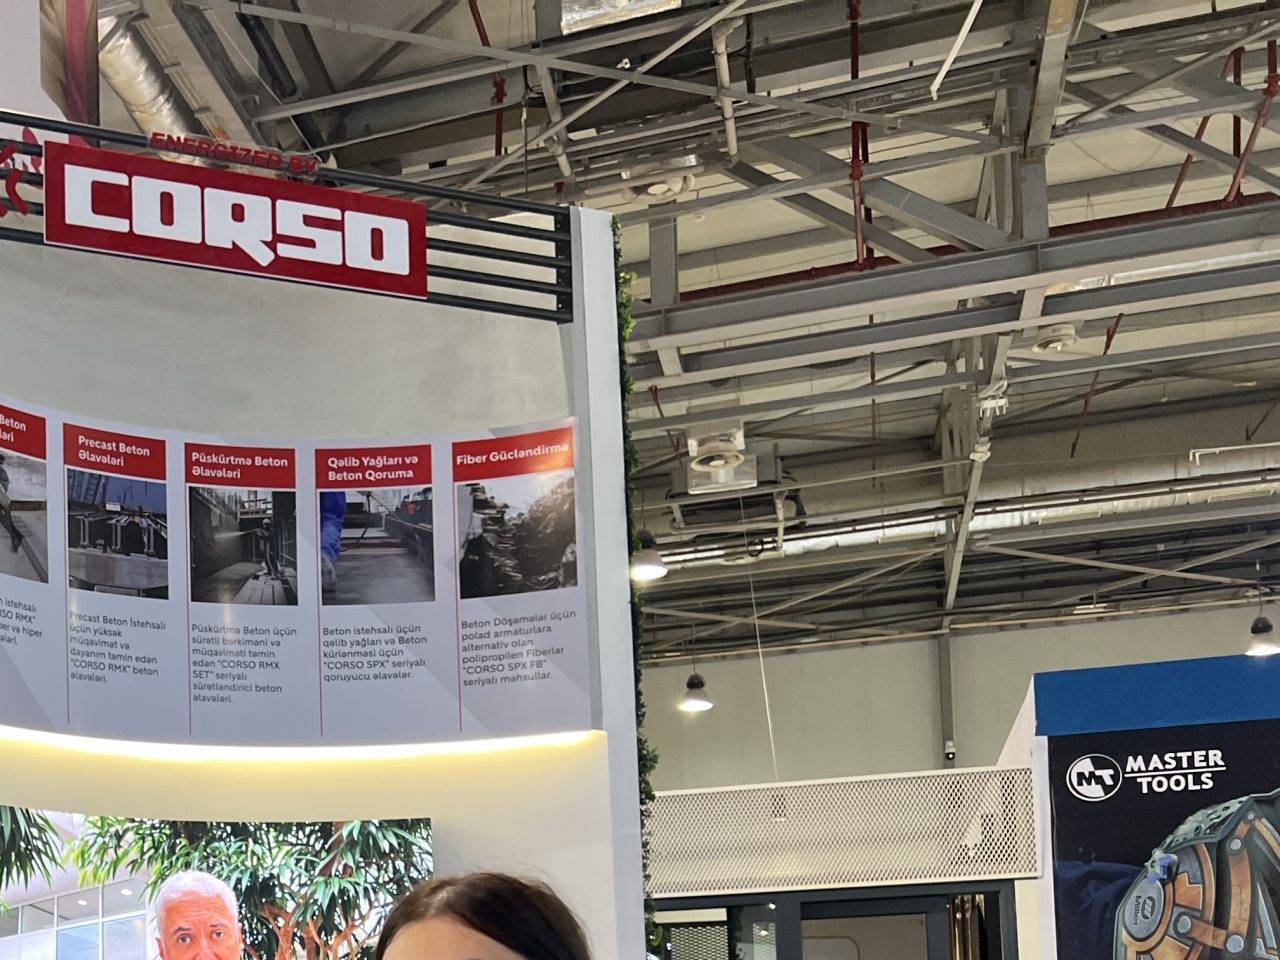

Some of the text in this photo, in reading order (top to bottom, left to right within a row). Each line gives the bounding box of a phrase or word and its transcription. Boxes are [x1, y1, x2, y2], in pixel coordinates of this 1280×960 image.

[64, 164, 410, 276] CORSO
[78, 435, 150, 457] Precast Beton
[78, 449, 124, 466] Əlavələri
[192, 452, 288, 468] Püskürtmə Beton
[328, 456, 419, 468] Qəlib Yağları və
[456, 455, 488, 465] Fiber
[192, 466, 240, 479] Əlavələri
[328, 469, 414, 481] Beton Qoruma
[102, 616, 128, 626] Beton
[462, 620, 490, 629] Beton
[243, 626, 270, 635] Beton
[323, 628, 350, 636] Beton
[398, 636, 427, 644] Beton
[133, 666, 158, 676] beton
[258, 662, 280, 670] RMX
[1126, 750, 1226, 772] MASTER
[1136, 773, 1214, 794] TOOLS
